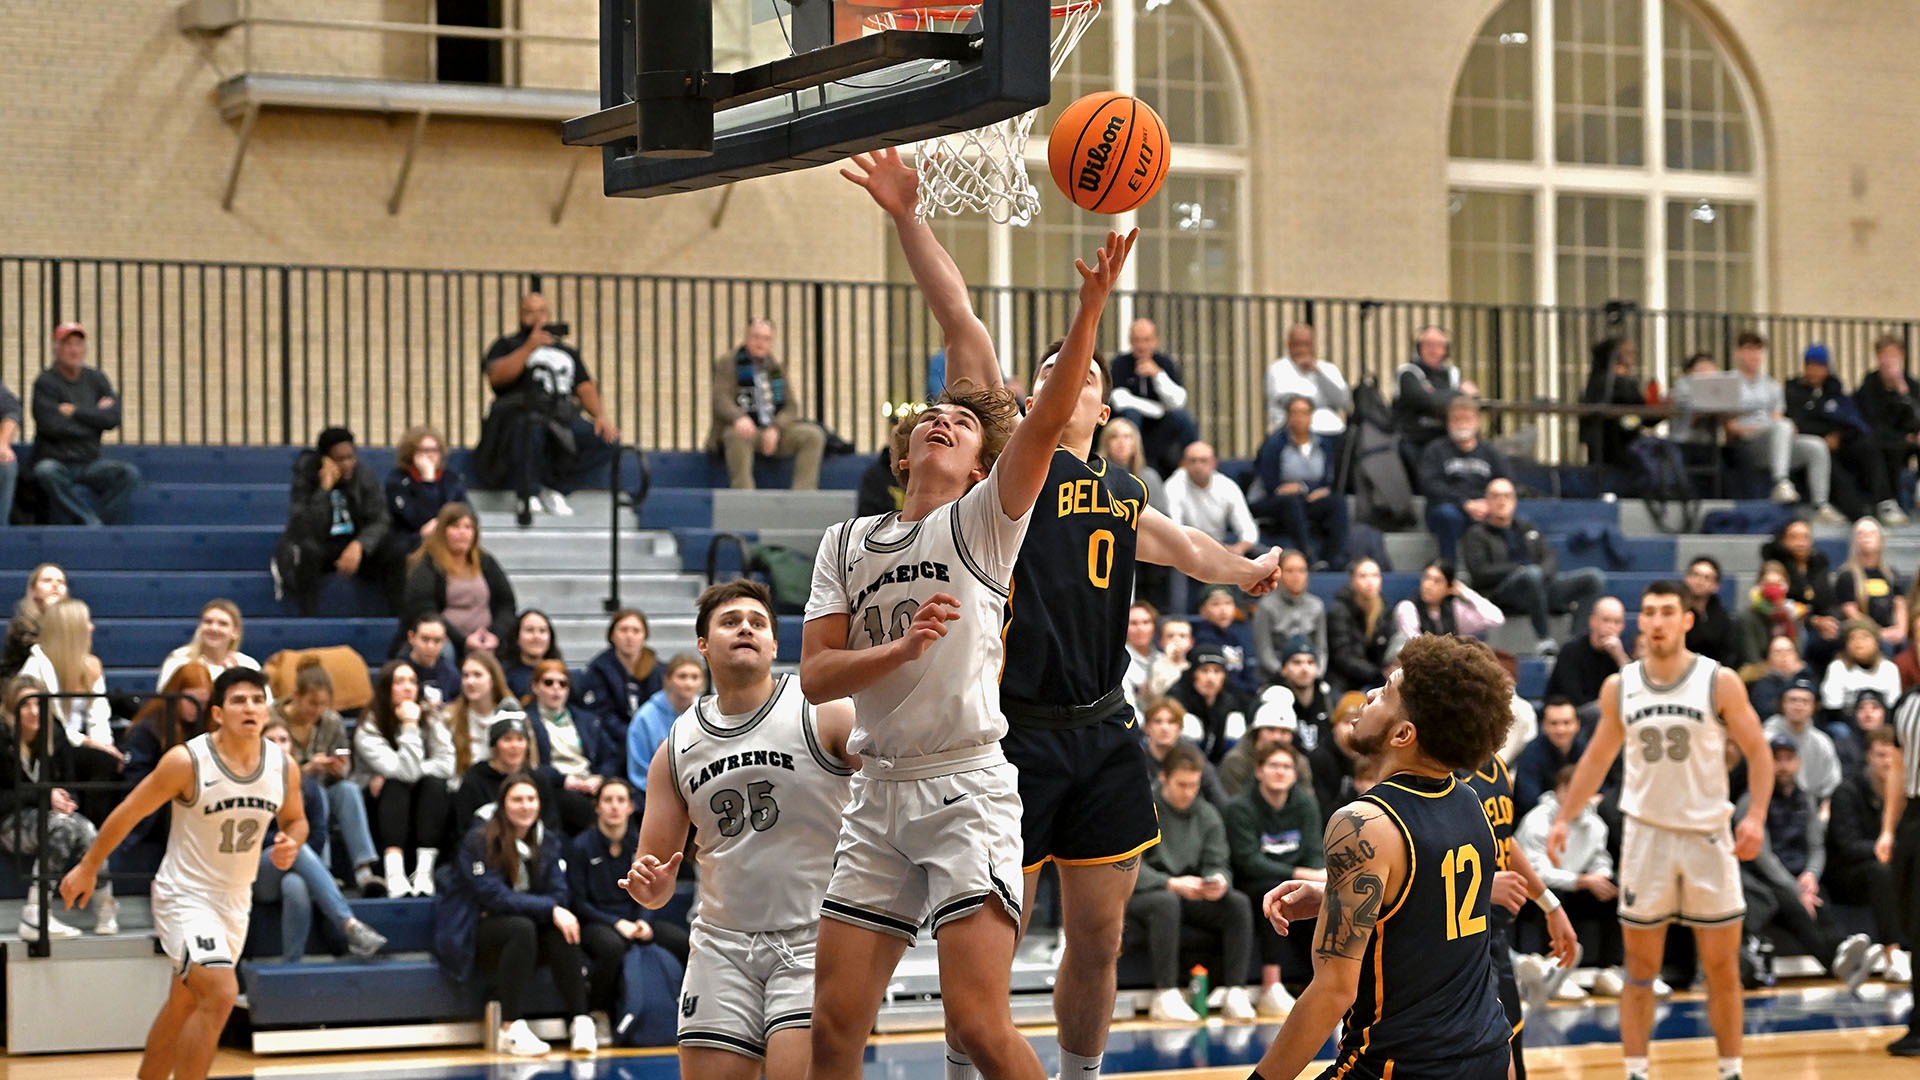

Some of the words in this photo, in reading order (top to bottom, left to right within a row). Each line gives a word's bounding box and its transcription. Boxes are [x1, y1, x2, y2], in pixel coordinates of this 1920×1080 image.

[1078, 116, 1126, 192] Wilson
[1088, 529, 1115, 589] 0
[689, 750, 795, 794] LAWRENCE
[1640, 725, 1691, 764] 33
[218, 818, 259, 853] 12
[710, 780, 780, 837] 35
[1440, 843, 1487, 941] 12
